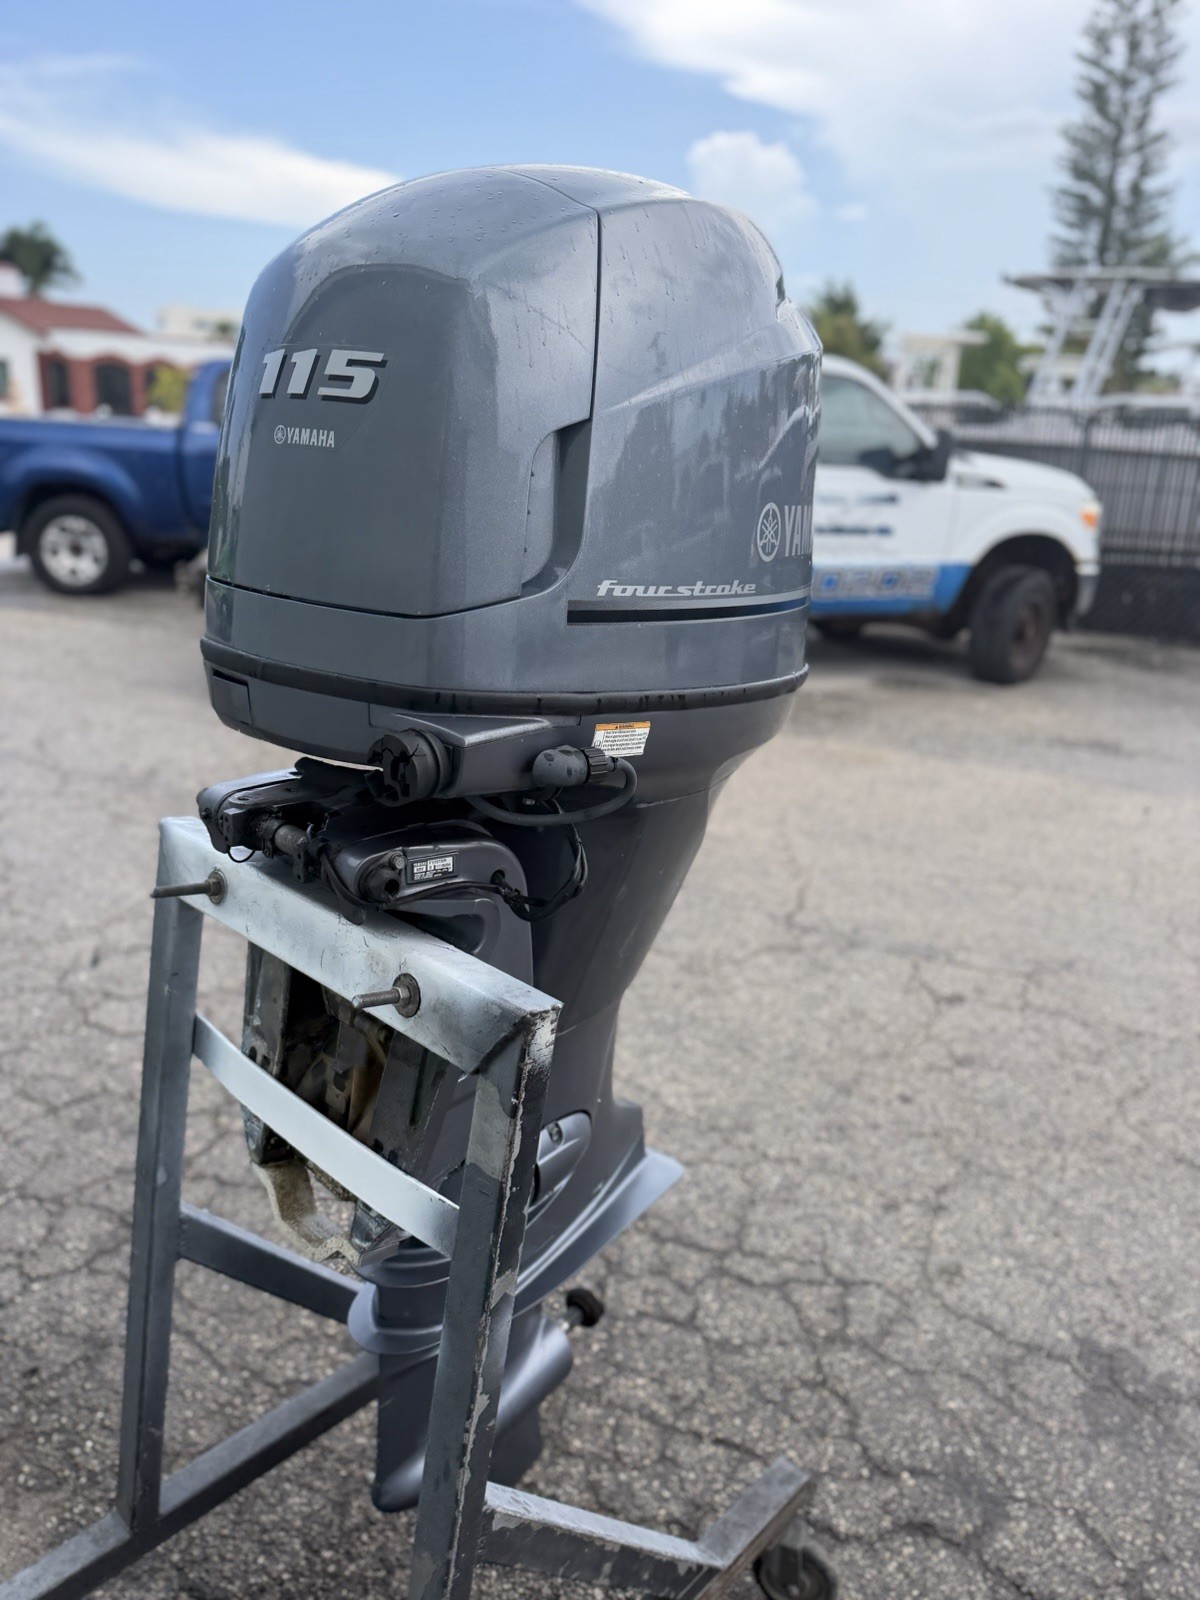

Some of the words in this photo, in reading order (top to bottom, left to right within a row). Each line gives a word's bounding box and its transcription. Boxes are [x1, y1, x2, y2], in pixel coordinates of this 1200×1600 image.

[259, 348, 388, 404] 115
[287, 427, 335, 448] YAMAHA
[784, 504, 812, 558] YAM
